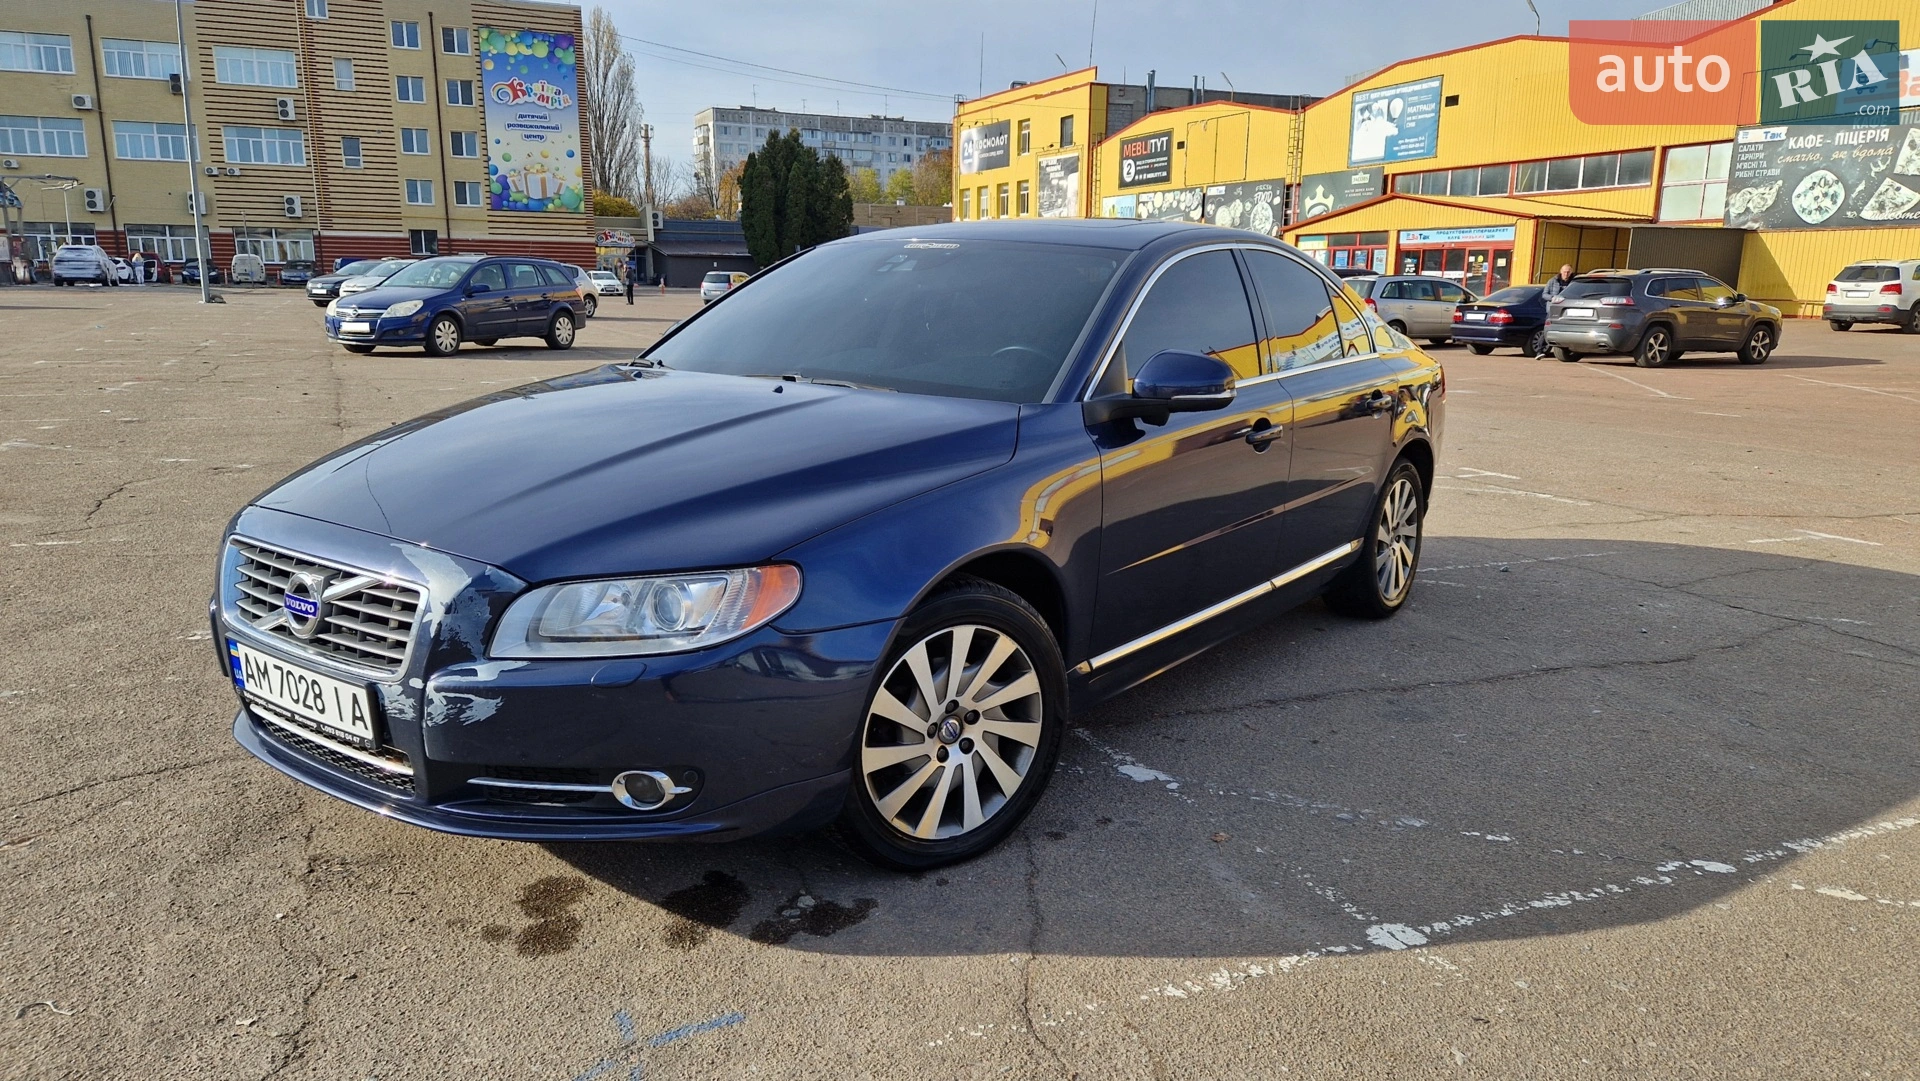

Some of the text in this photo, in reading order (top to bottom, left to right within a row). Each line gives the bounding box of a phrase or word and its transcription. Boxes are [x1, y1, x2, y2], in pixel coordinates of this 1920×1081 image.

[517, 113, 548, 121] дитячий
[506, 122, 560, 131] розважальний
[1788, 134, 1825, 150] КАФЕ
[1835, 128, 1890, 146] ПІЦЕРІЯ
[963, 140, 973, 157] 24
[1123, 136, 1169, 158] MEBLITYT
[1738, 144, 1764, 153] САЛАТИ
[1777, 145, 1895, 164] смачно, як вдома
[1737, 153, 1765, 161] ГАРНІРИ
[1735, 168, 1781, 178] РИБНІ СТРАВИ
[285, 597, 315, 614] VOLVO
[234, 667, 243, 681] UA
[244, 652, 273, 695] AM
[273, 664, 326, 715] 7028
[334, 686, 369, 731] IA
